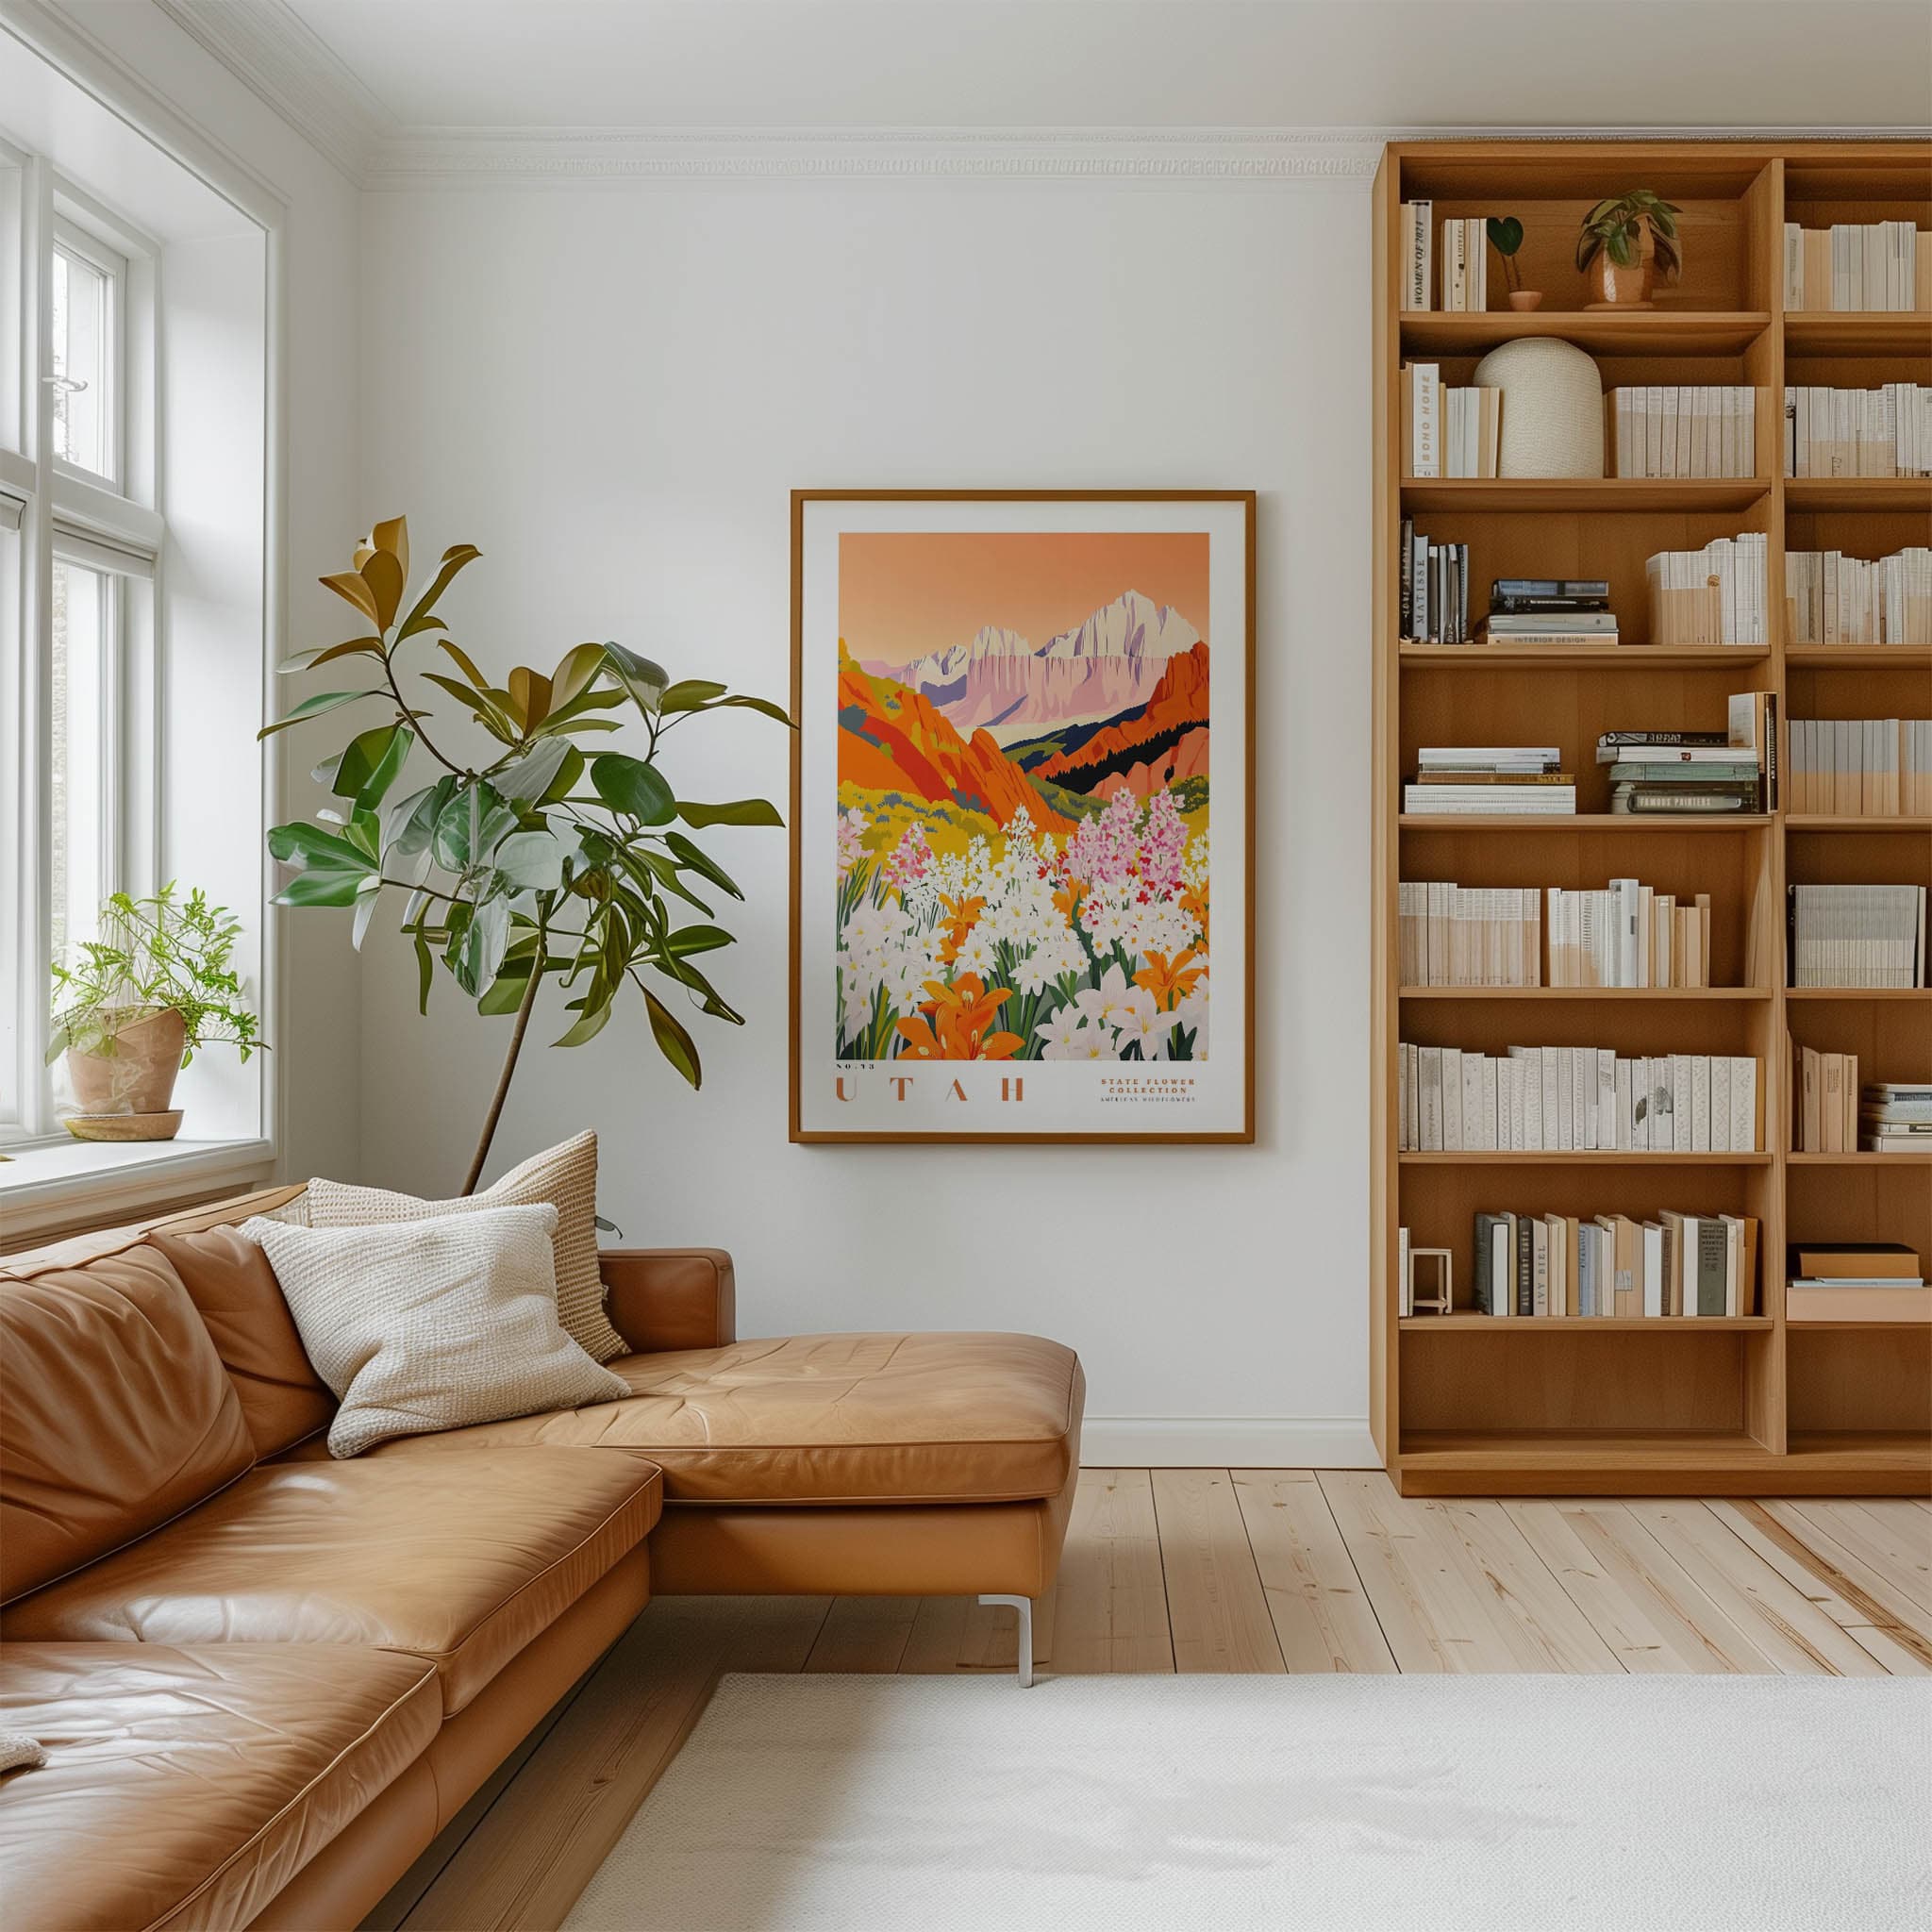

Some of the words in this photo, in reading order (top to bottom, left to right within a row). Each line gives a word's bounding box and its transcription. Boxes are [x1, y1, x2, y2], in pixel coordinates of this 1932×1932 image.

[1413, 244, 1424, 260] OF
[1413, 262, 1424, 305] WOMEN
[1421, 375, 1431, 416] HOME
[1421, 422, 1431, 461] BOHO
[1416, 559, 1425, 625] MATISSE
[1640, 797, 1672, 807] FAMOUS
[836, 1077, 1024, 1102] UTAH
